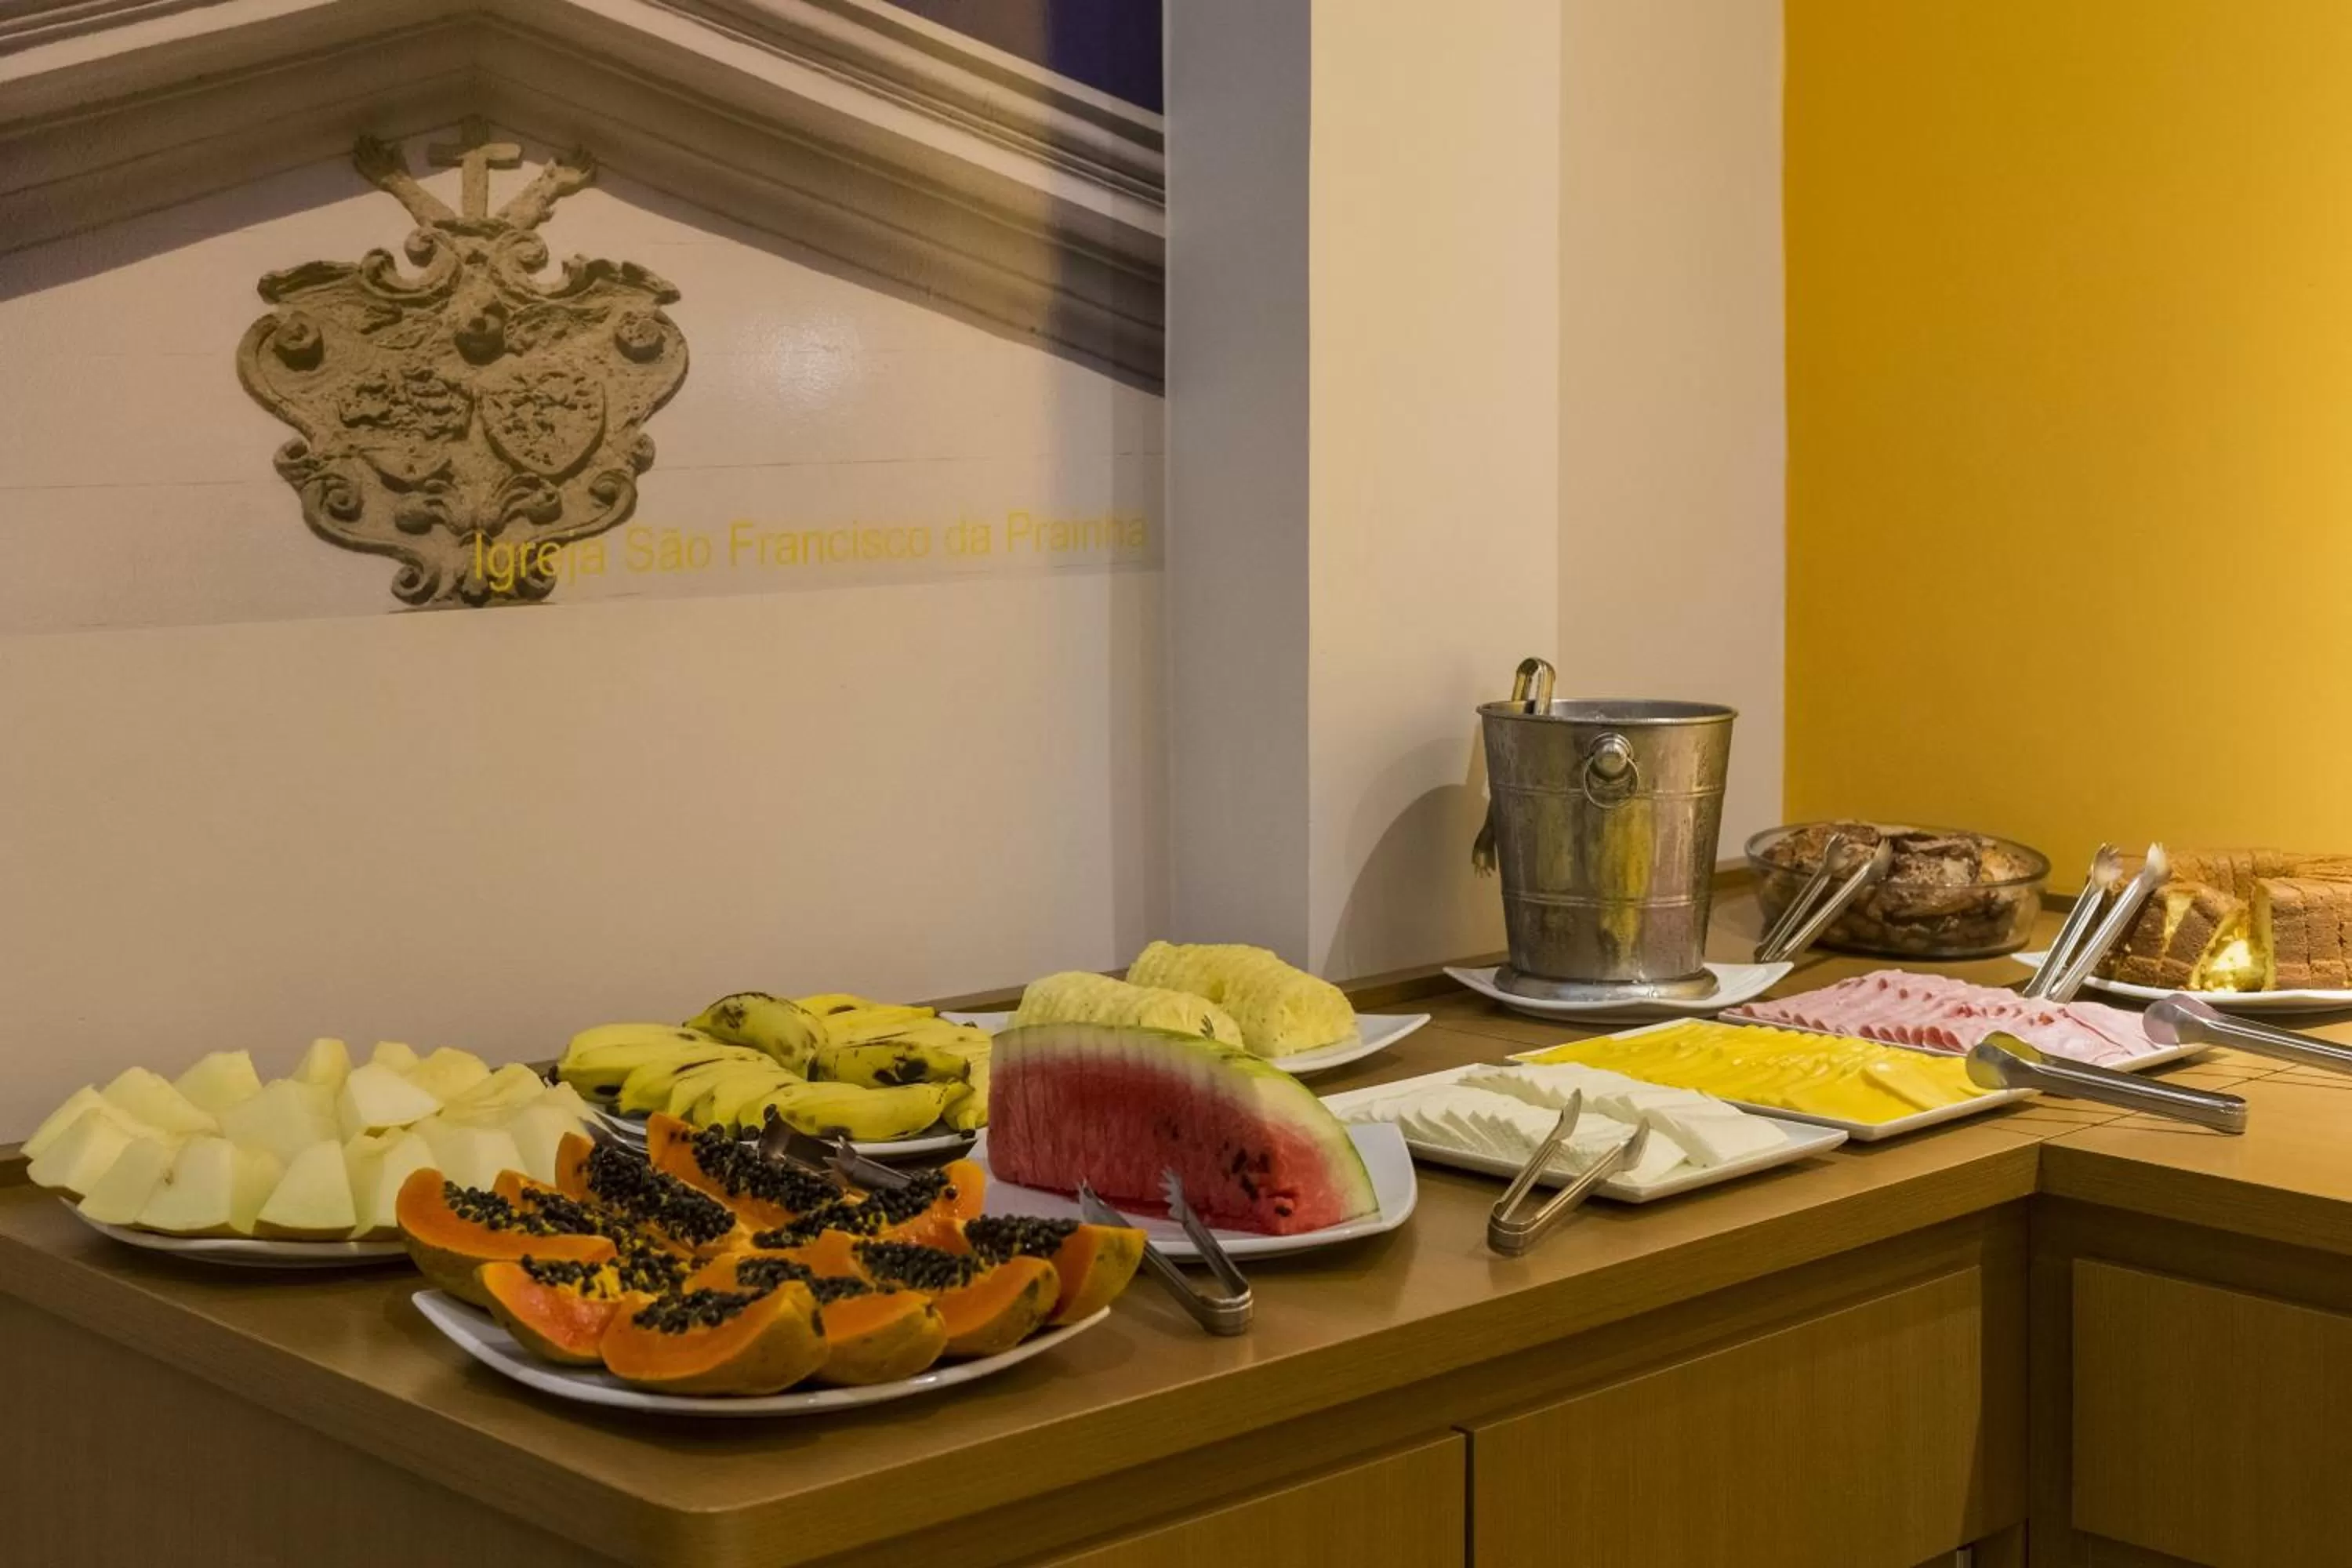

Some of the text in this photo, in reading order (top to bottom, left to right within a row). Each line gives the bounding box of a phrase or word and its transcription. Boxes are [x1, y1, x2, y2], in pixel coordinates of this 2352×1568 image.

[473, 509, 1149, 592] Igreja São Francisco da Prainha
